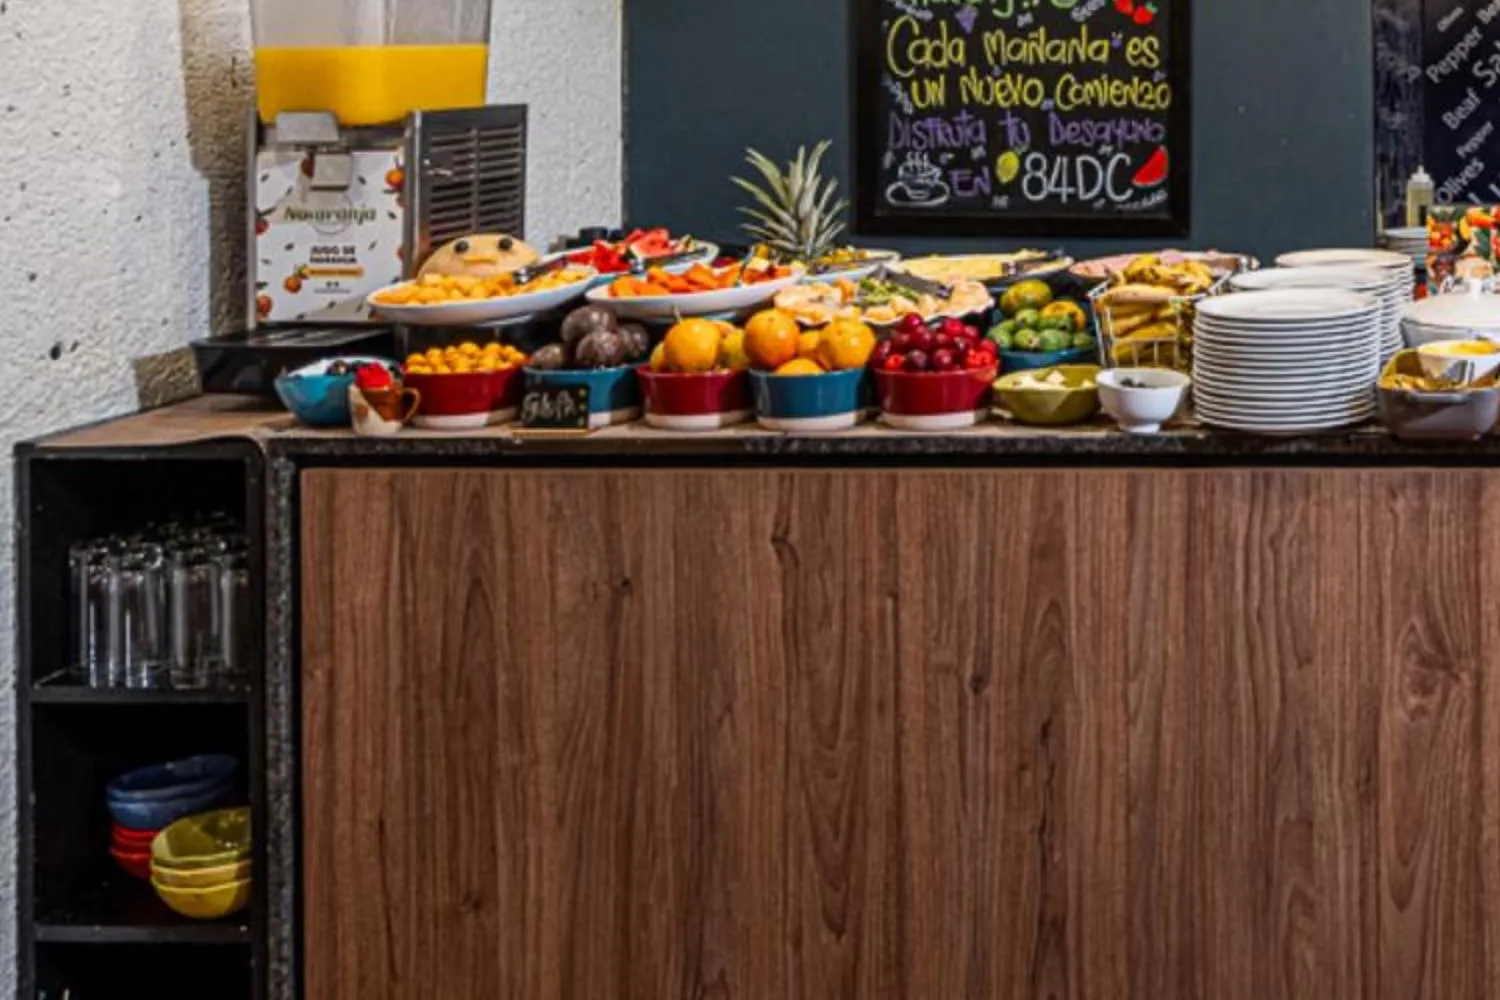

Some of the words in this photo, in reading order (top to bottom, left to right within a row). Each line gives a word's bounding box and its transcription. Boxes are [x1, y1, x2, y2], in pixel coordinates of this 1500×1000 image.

[887, 15, 966, 78] Cada
[1126, 36, 1160, 69] es
[1425, 26, 1483, 84] Pepper
[1441, 86, 1481, 130] Beaf
[1022, 151, 1134, 203] 84DC
[1435, 157, 1485, 205] Olives
